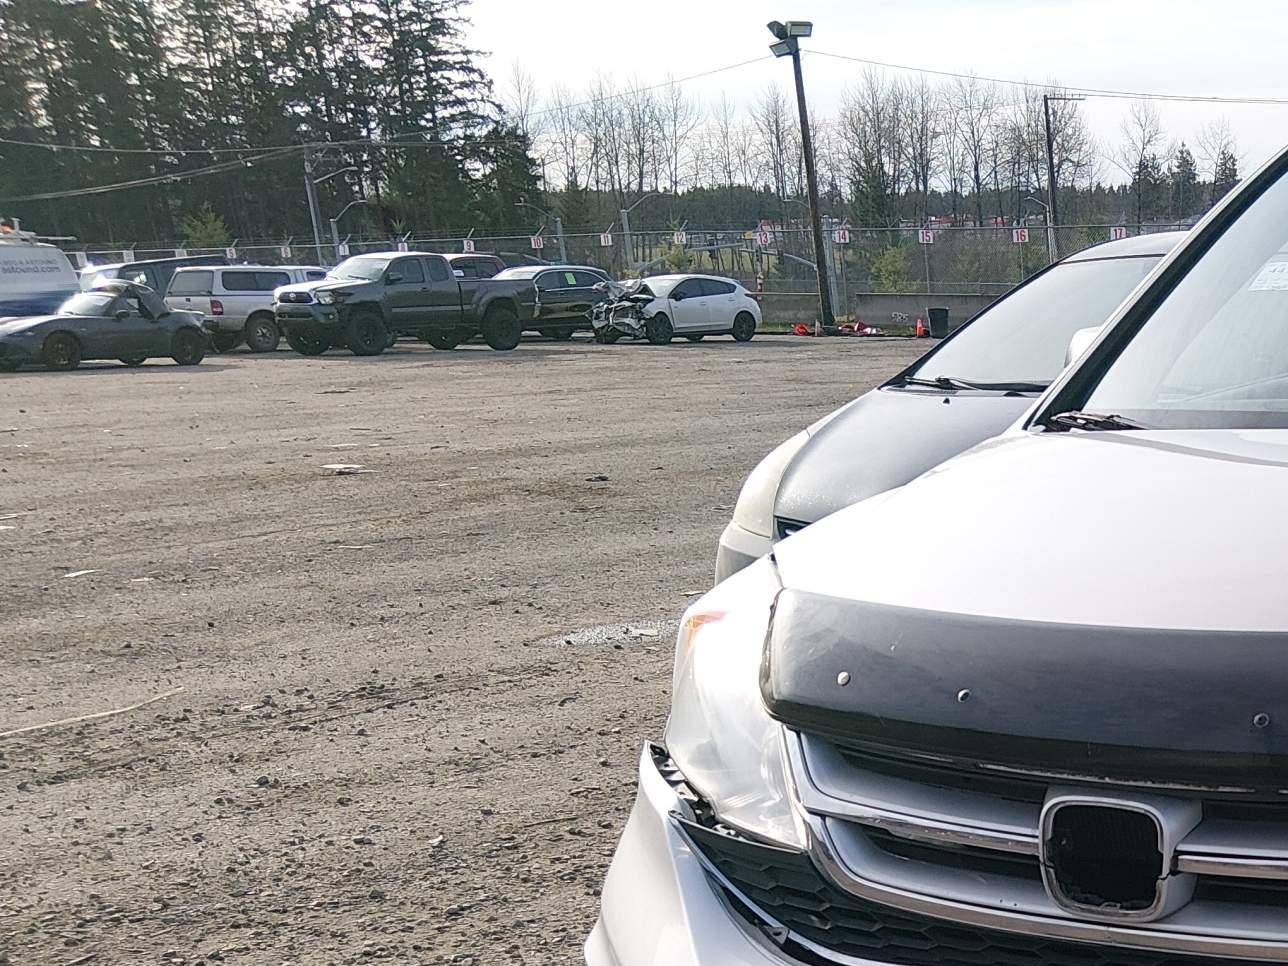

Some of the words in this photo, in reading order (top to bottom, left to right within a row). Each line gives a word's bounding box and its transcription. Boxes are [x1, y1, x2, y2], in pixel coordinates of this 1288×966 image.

[676, 232, 685, 242] 12
[759, 233, 769, 244] 13
[838, 231, 847, 242] 14
[921, 231, 931, 242] 15
[1015, 230, 1026, 242] 16
[1114, 227, 1123, 239] 17
[533, 237, 541, 248] 10
